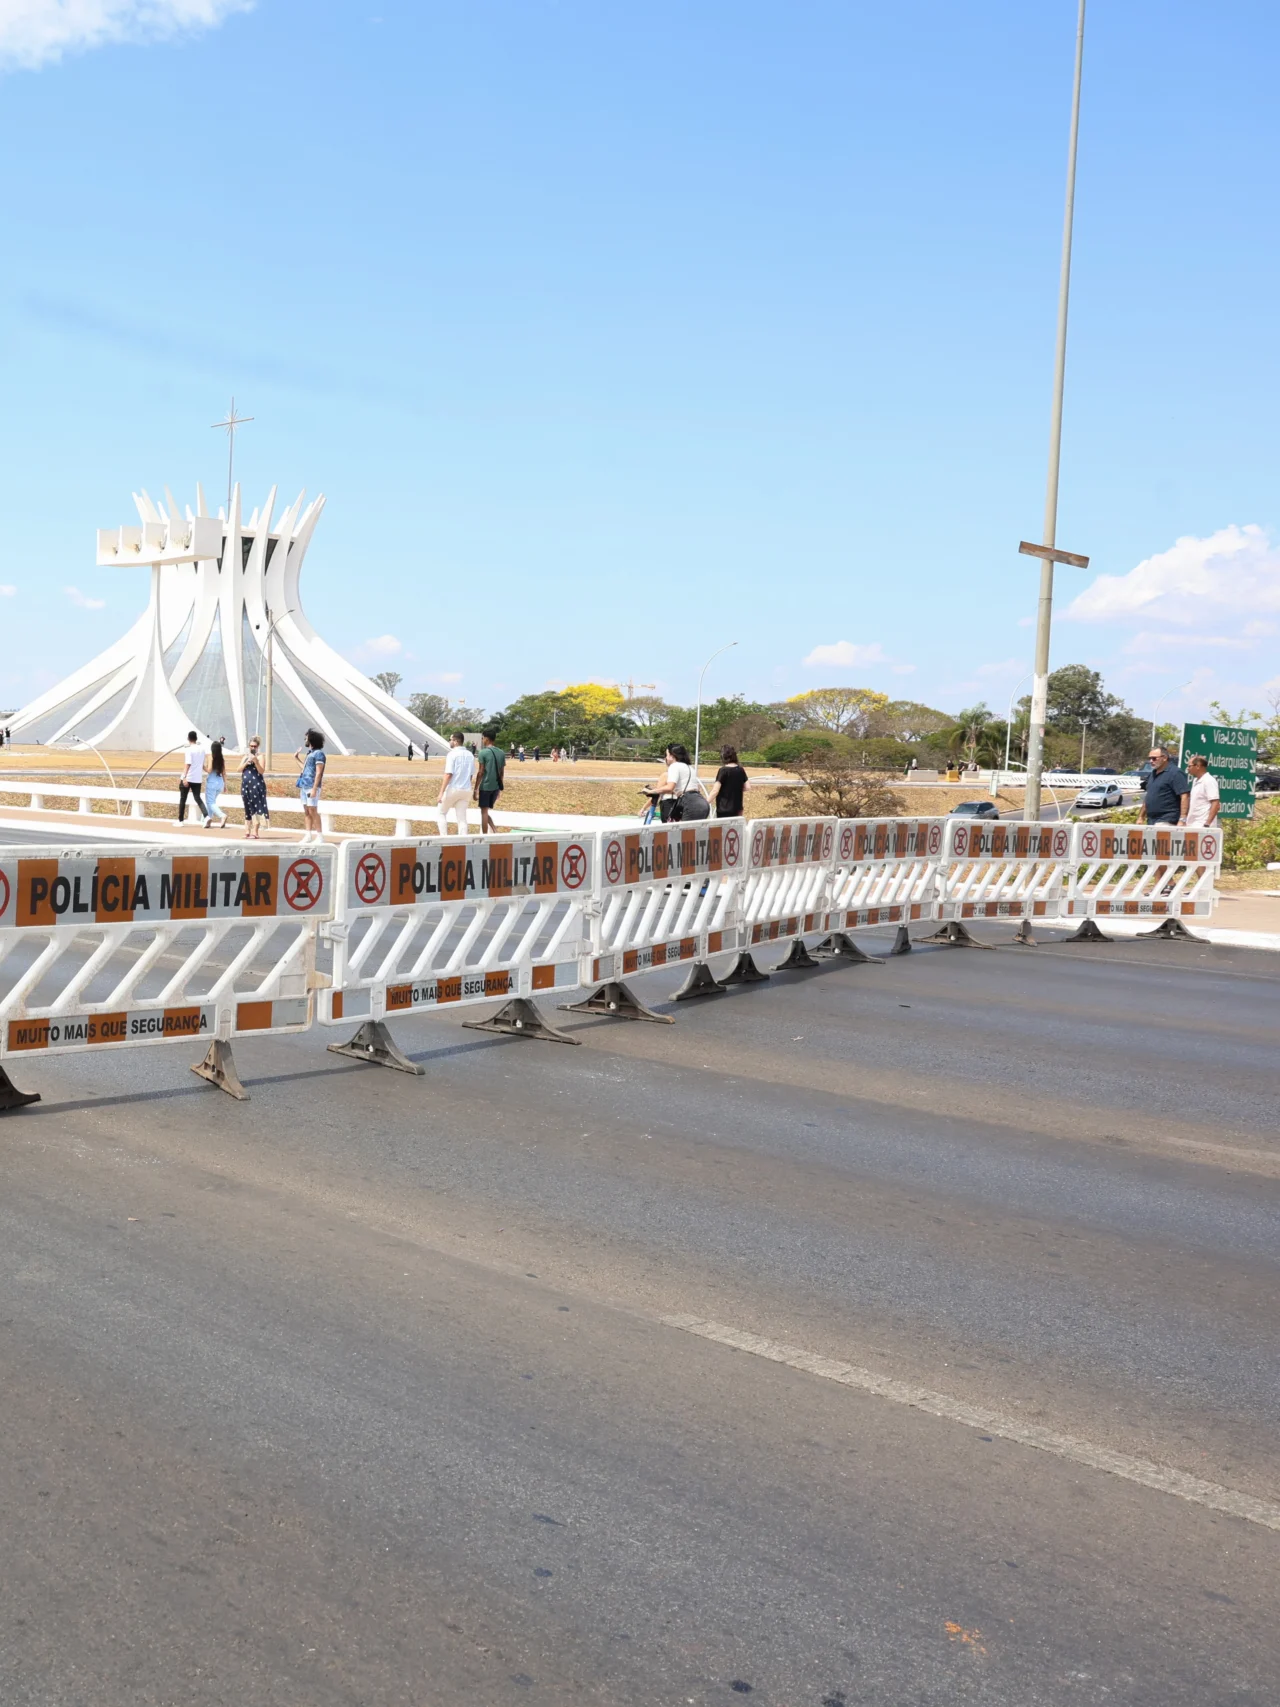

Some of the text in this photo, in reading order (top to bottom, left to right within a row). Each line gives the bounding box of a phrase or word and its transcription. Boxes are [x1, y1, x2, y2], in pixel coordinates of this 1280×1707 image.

[1237, 732, 1249, 747] Sul
[1208, 753, 1248, 772] Autarquias
[629, 839, 720, 875] POLÍCIA MILITAR
[1104, 834, 1196, 856] POLÍCIA MILITAR
[398, 853, 554, 895] POLÍCIA MILITAR
[29, 866, 272, 915] POLÍCIA MILITAR
[391, 977, 514, 1004] MUITO MAIS QUE SEGURANÇA
[16, 1014, 207, 1044] MUITO MAIS QUE SEGURANÇA
